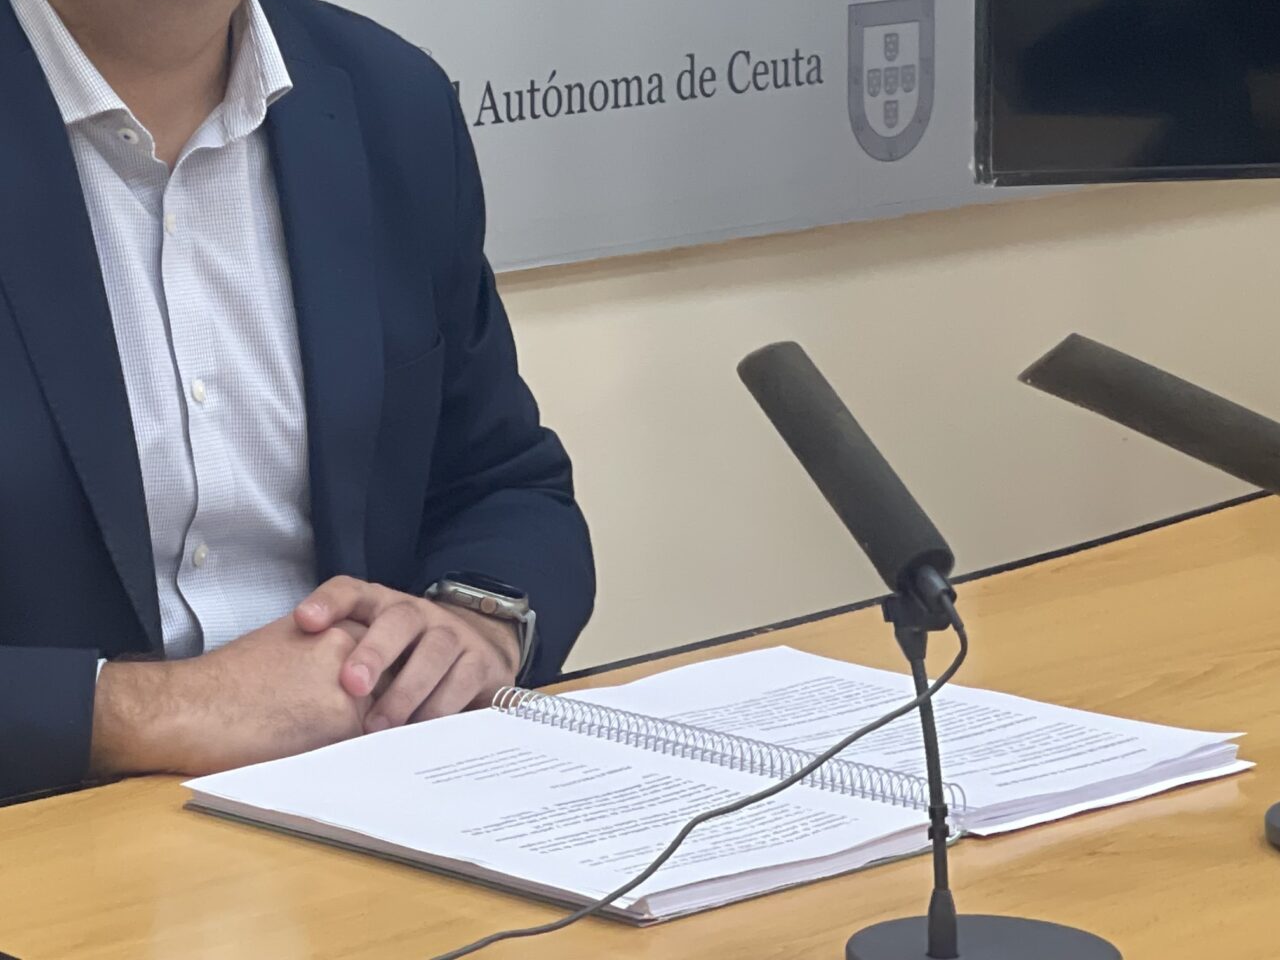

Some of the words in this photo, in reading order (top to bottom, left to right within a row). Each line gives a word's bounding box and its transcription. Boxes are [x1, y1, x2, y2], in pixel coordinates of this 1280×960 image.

[472, 68, 667, 127] Autónoma
[675, 52, 717, 101] de
[726, 47, 825, 95] Ceuta
